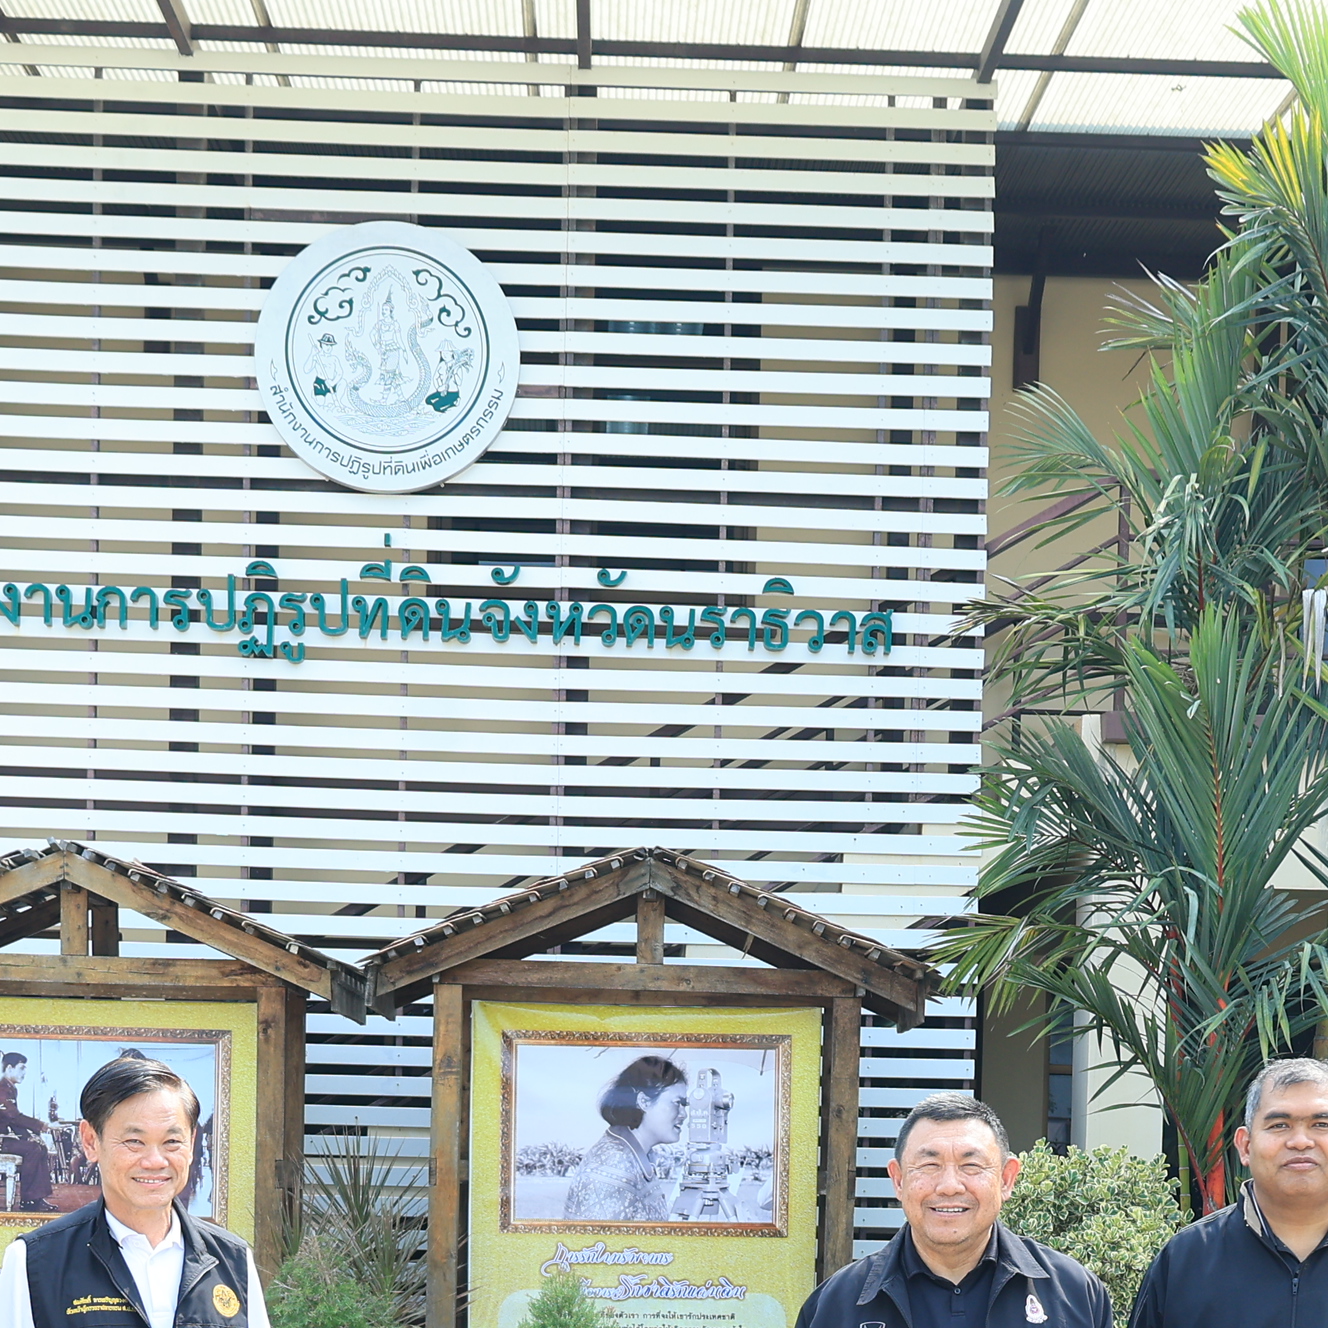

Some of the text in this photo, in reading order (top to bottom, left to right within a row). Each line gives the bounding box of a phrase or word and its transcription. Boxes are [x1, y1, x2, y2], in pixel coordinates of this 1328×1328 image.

[269, 384, 504, 480] สำนักงานการปฏิรูปที่ดินเพื่อเกษตรกรรม
